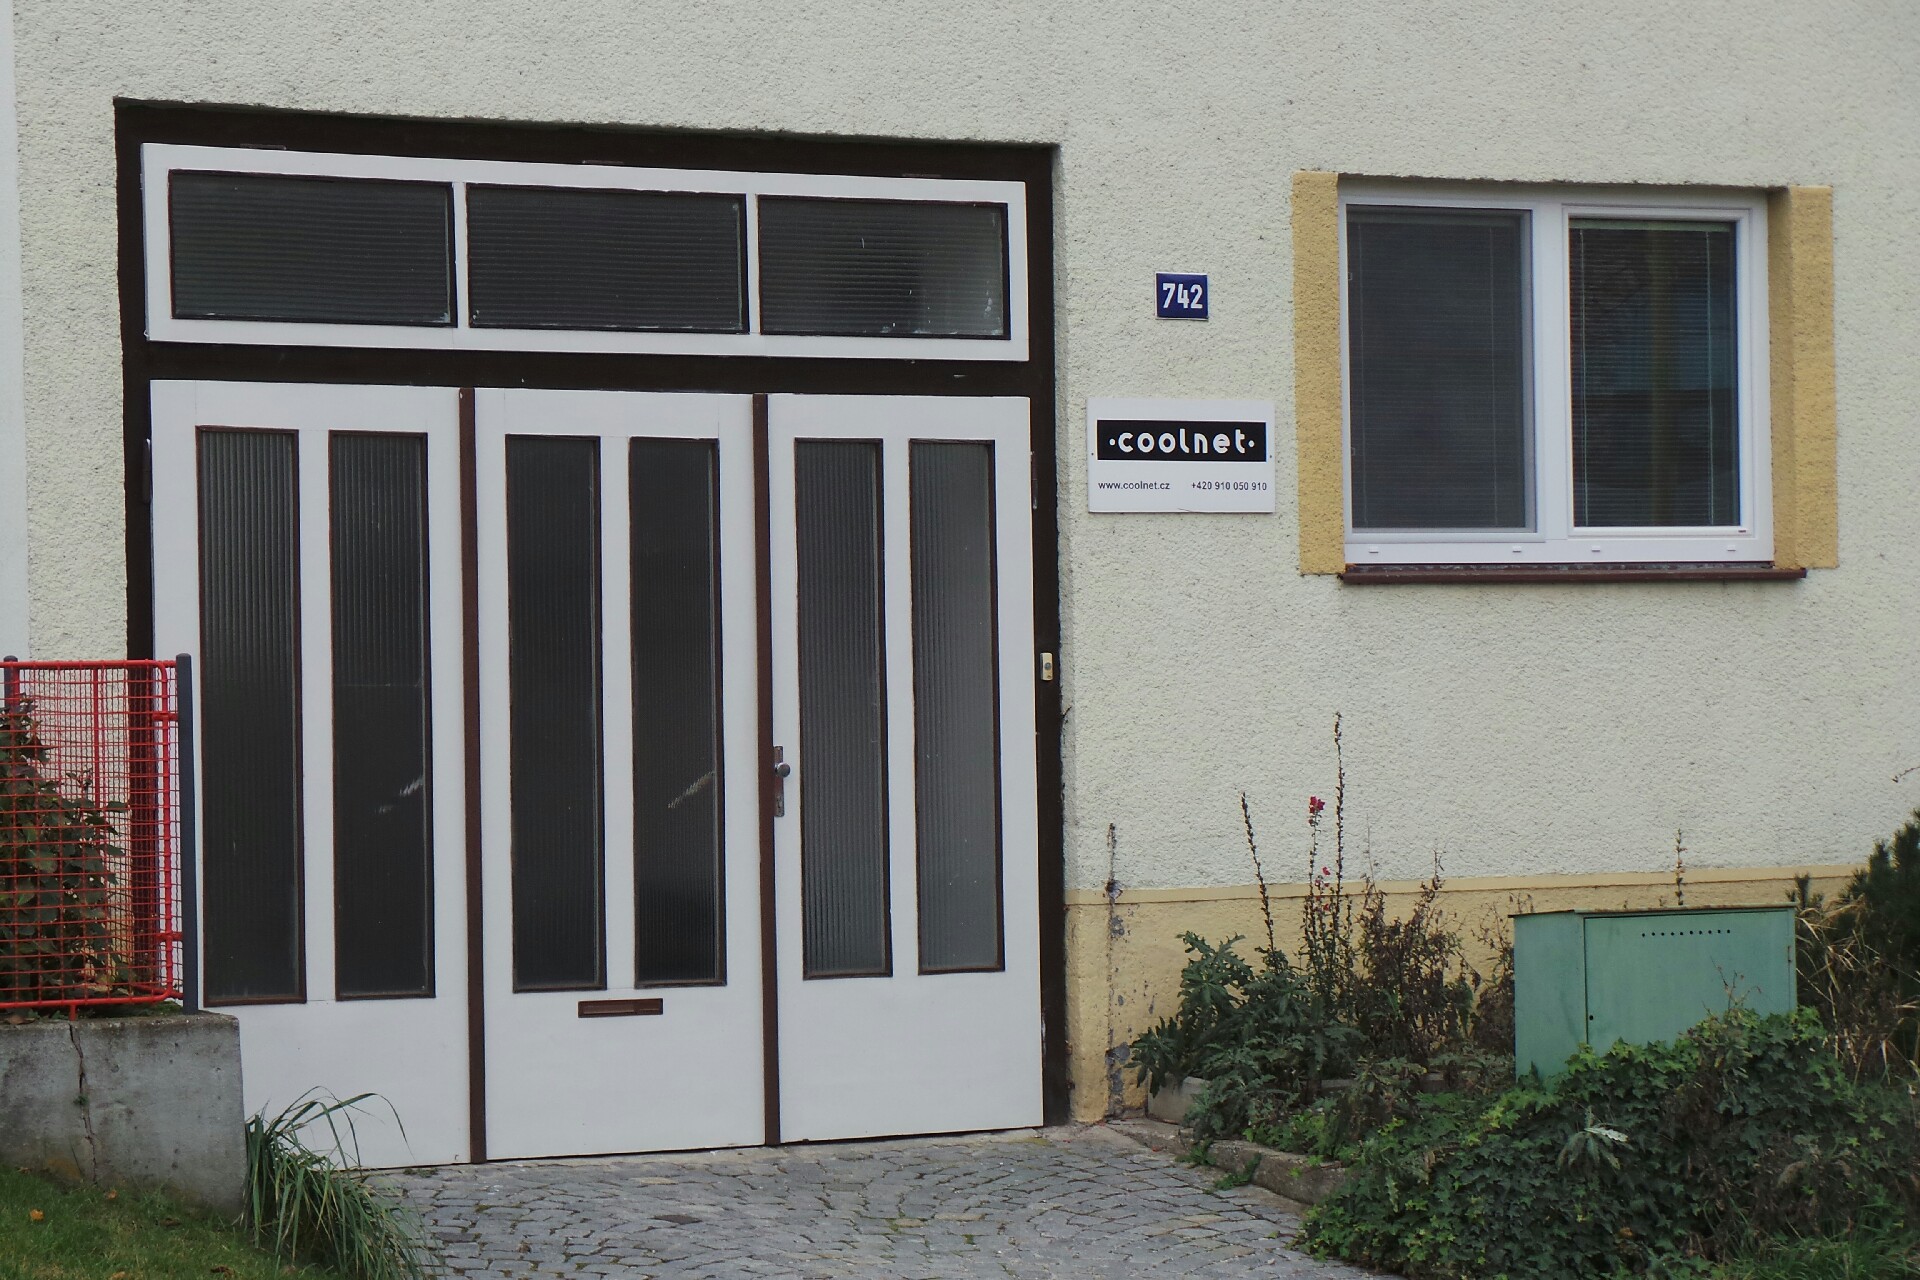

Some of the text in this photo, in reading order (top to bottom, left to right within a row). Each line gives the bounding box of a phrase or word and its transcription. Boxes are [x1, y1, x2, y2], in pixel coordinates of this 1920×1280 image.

[1162, 282, 1203, 309] 742
[1098, 480, 1170, 490] www.coolnet.cz
[1191, 481, 1267, 491] +420 910 050 910
